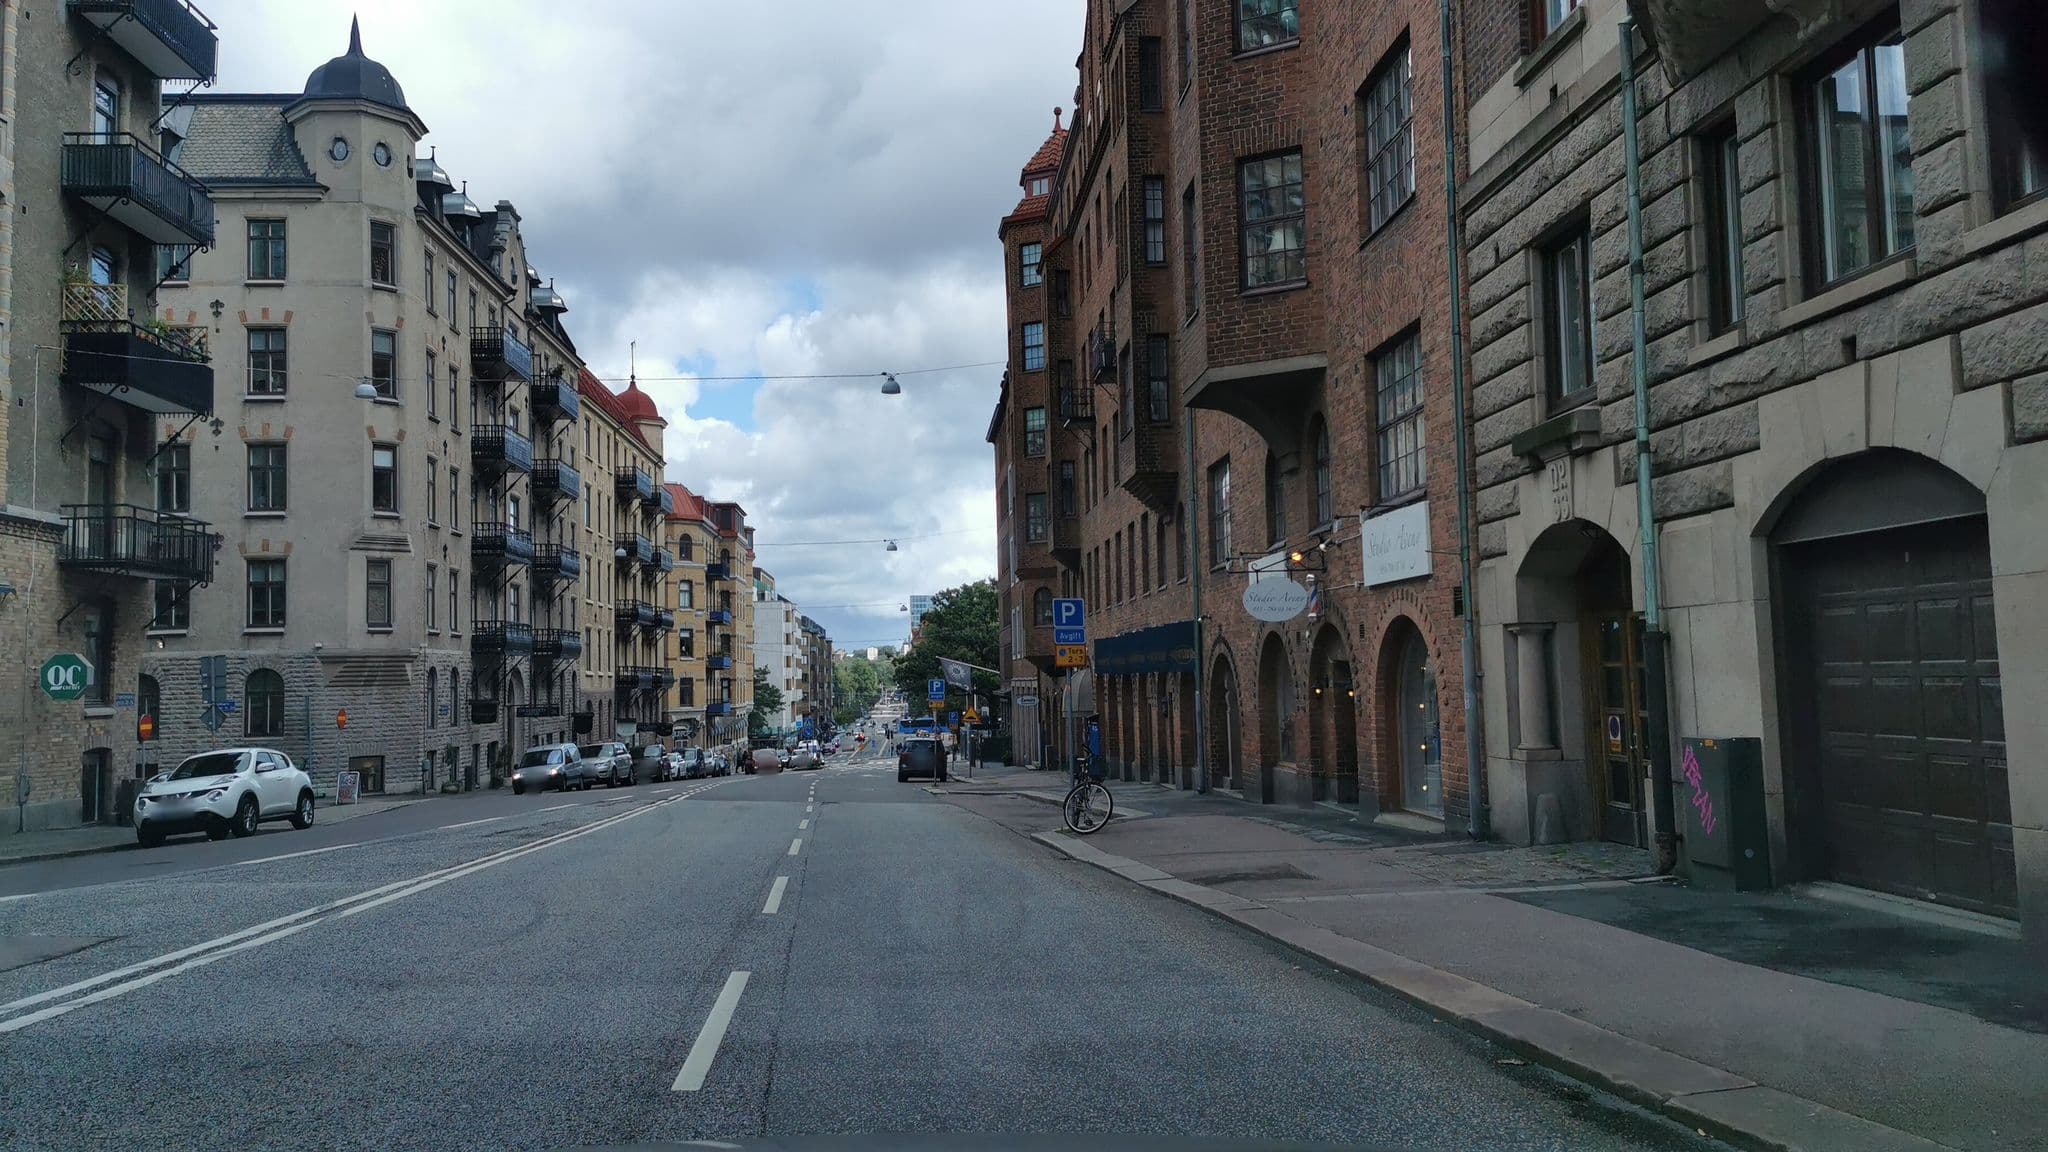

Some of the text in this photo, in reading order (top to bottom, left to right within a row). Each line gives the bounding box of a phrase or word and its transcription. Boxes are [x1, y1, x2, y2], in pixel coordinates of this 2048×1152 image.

[1062, 602, 1076, 624] P
[1060, 632, 1081, 641] Avgift
[933, 681, 941, 692] P
